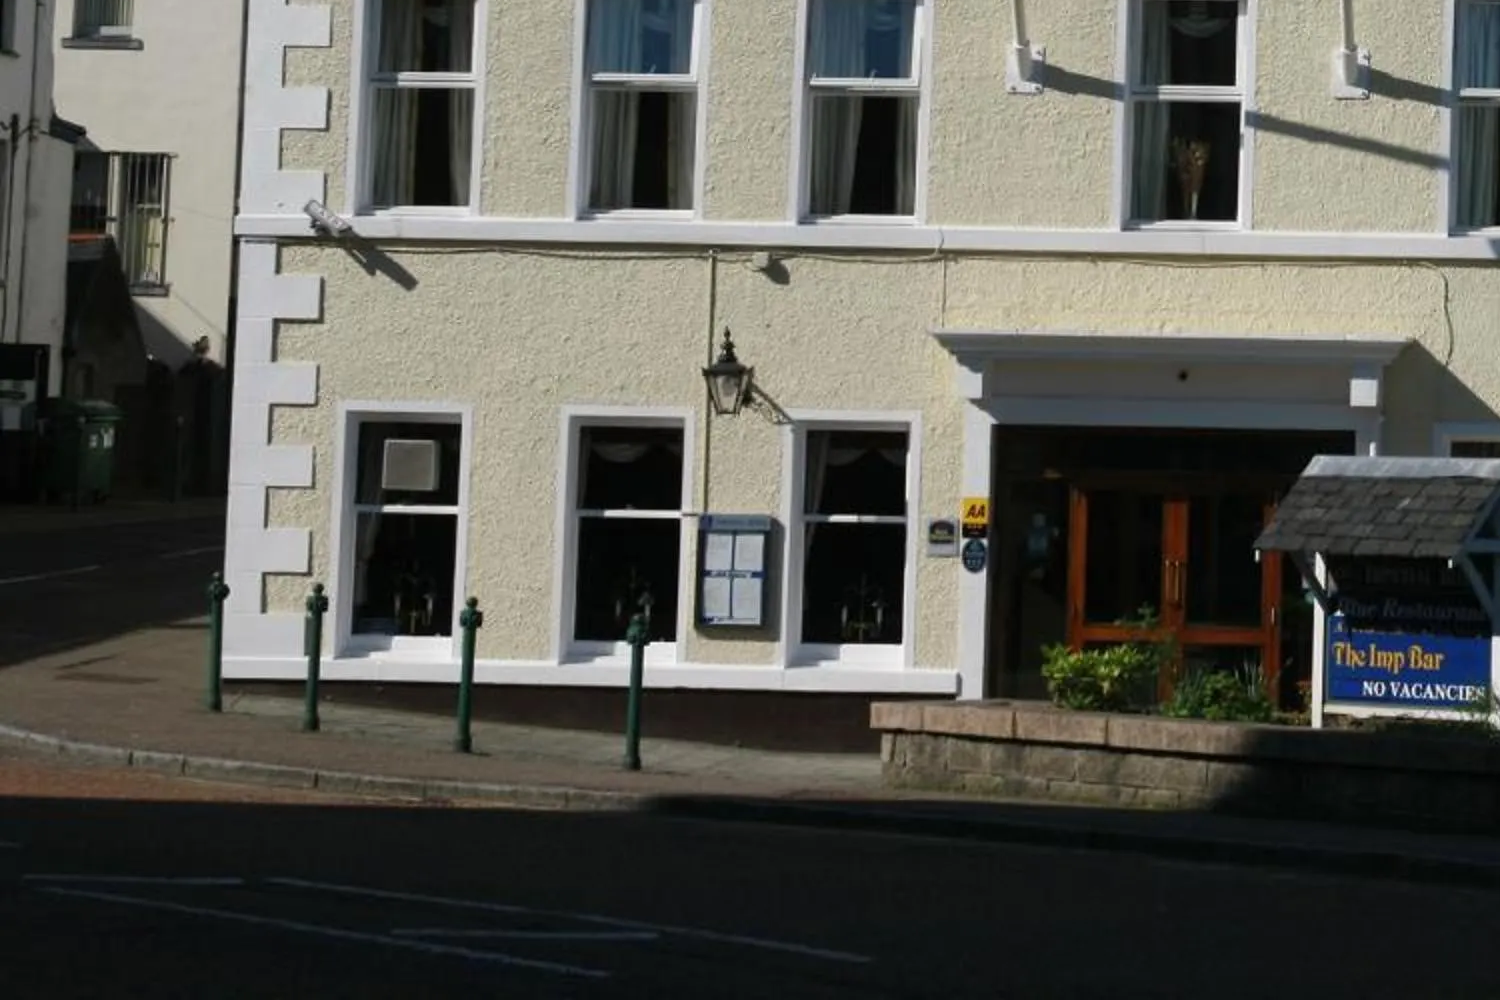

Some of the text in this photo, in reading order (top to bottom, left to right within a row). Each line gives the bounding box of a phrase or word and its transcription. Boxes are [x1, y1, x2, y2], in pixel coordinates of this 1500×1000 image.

[1333, 641, 1445, 675] The Imp Bar
[1362, 681, 1486, 701] NO VACANCIES
